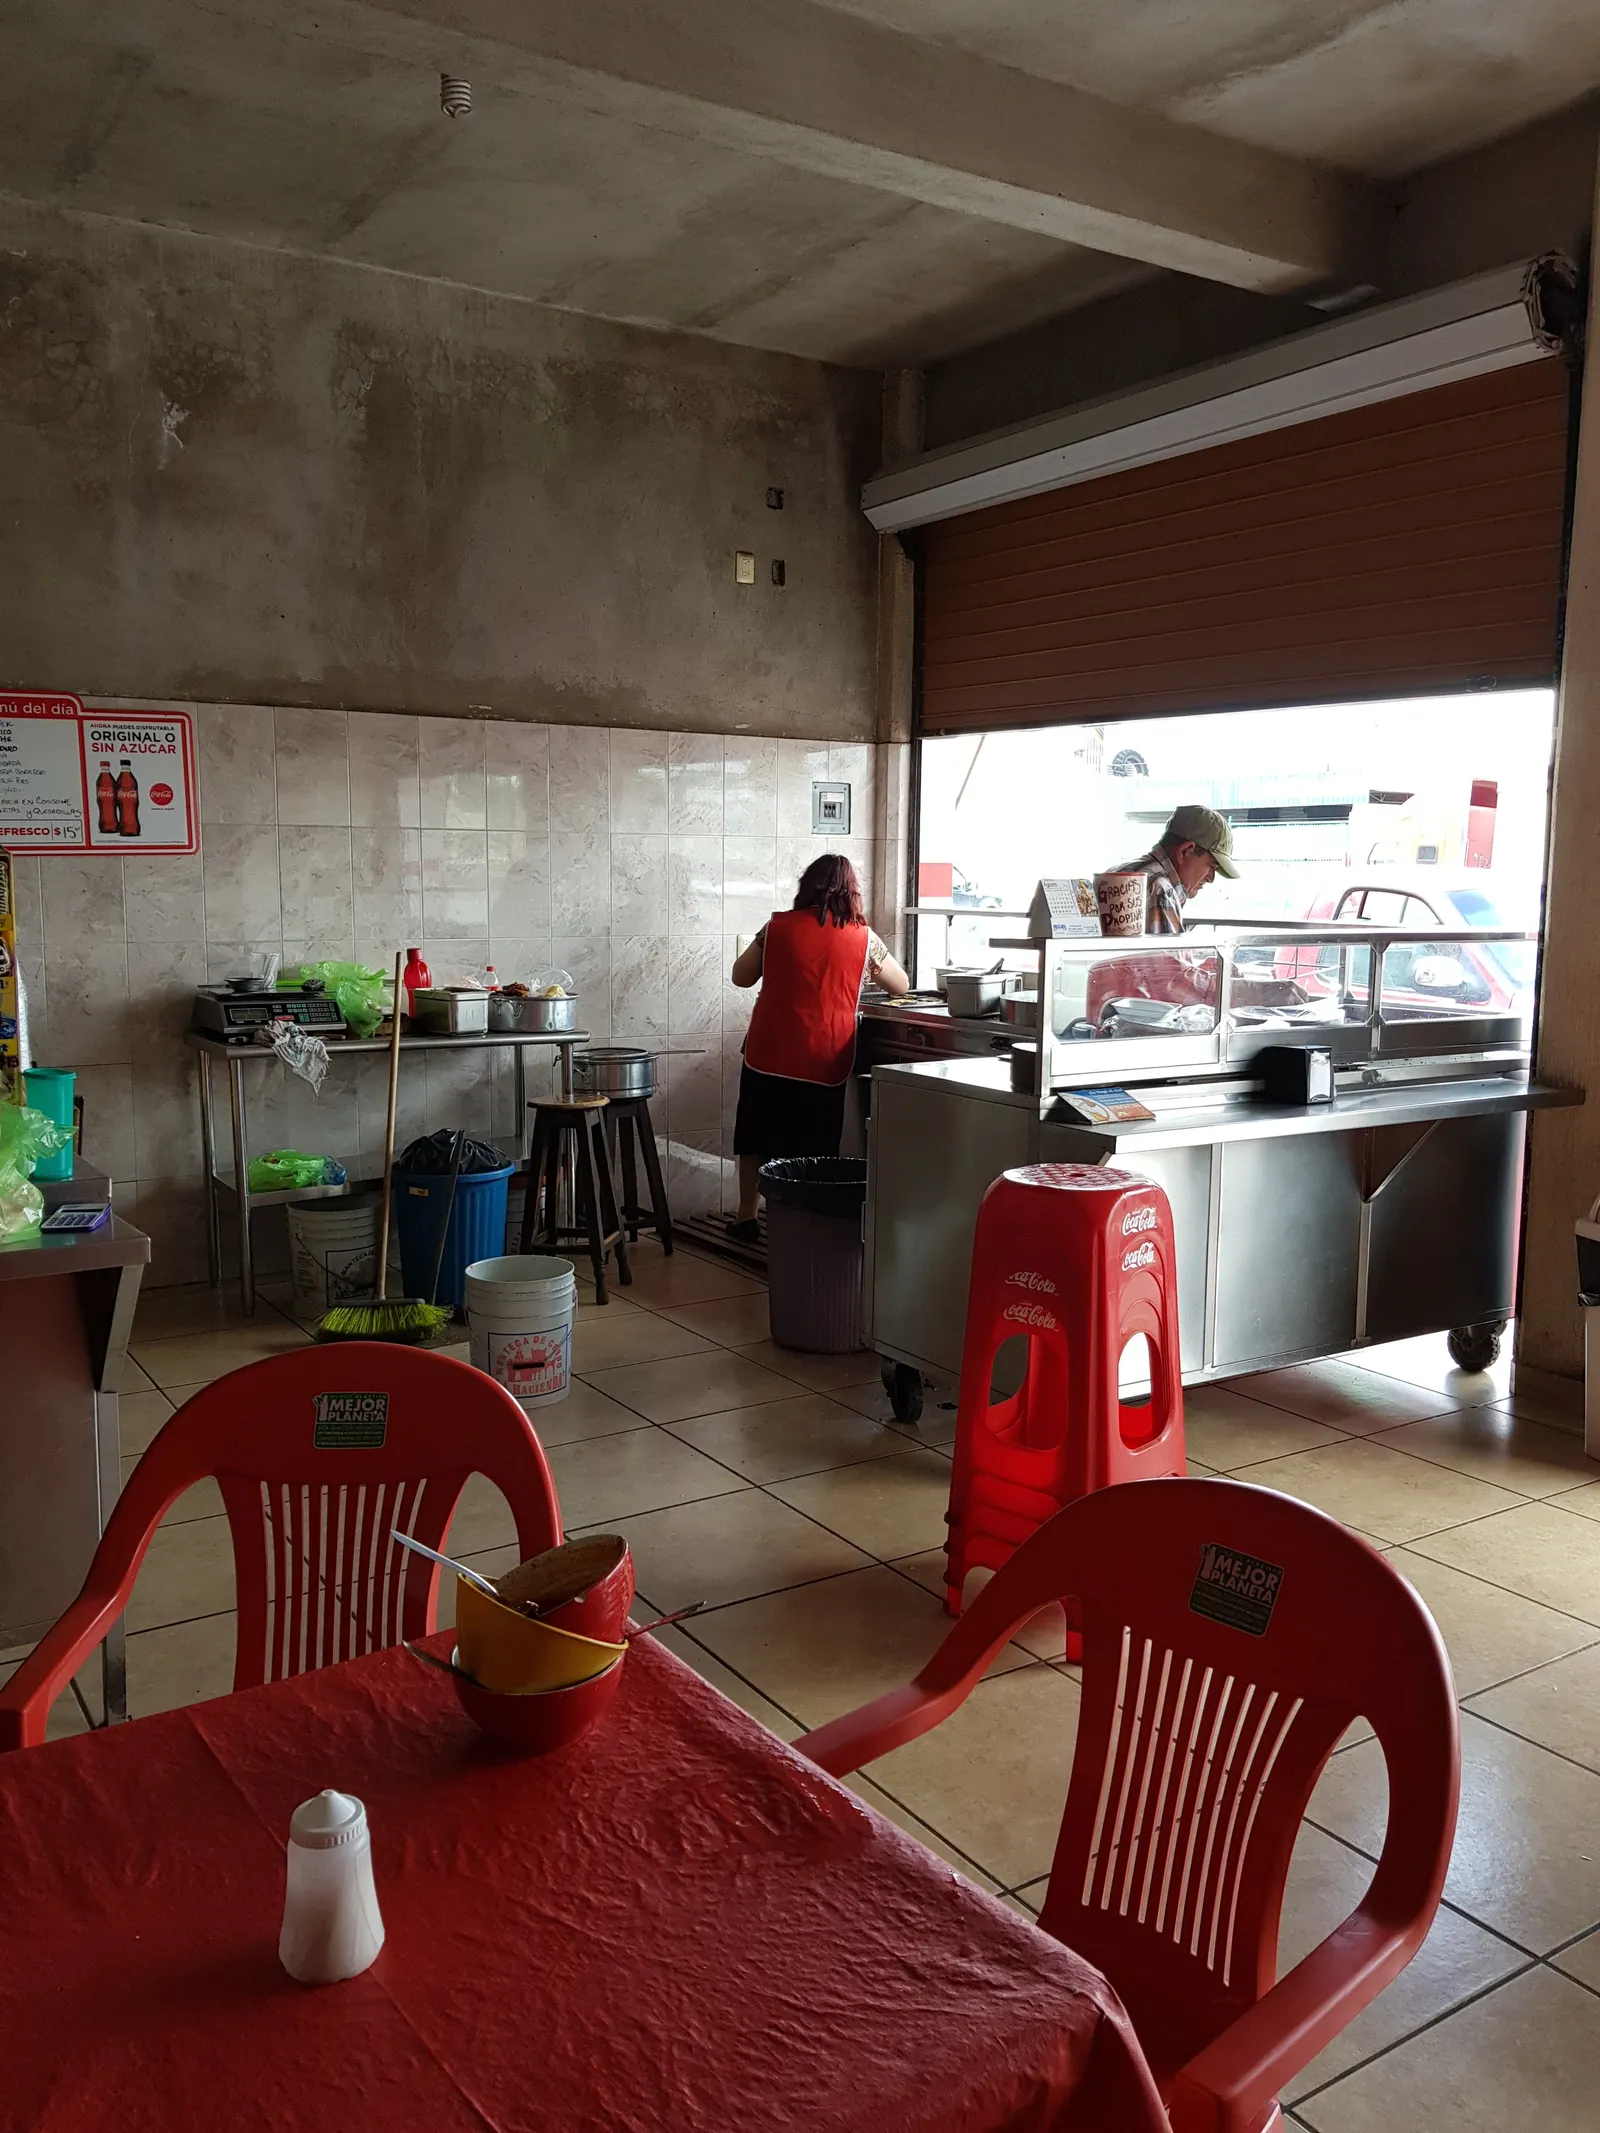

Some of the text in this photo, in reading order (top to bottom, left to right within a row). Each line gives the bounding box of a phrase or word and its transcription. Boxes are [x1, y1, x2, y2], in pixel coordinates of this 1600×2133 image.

[23, 702, 46, 714] del
[51, 703, 74, 715] día
[91, 730, 176, 743] ORIGINAL O
[91, 742, 115, 753] SIN
[54, 827, 61, 837] $
[1100, 908, 1143, 933] PROPINA
[1122, 1207, 1156, 1236] Coca-Cola
[533, 1336, 547, 1344] DE
[329, 1399, 385, 1411] MEJOR
[327, 1411, 385, 1421] PLANETA
[1215, 1555, 1278, 1591] MEJOR
[1210, 1569, 1273, 1604] PLANETA
